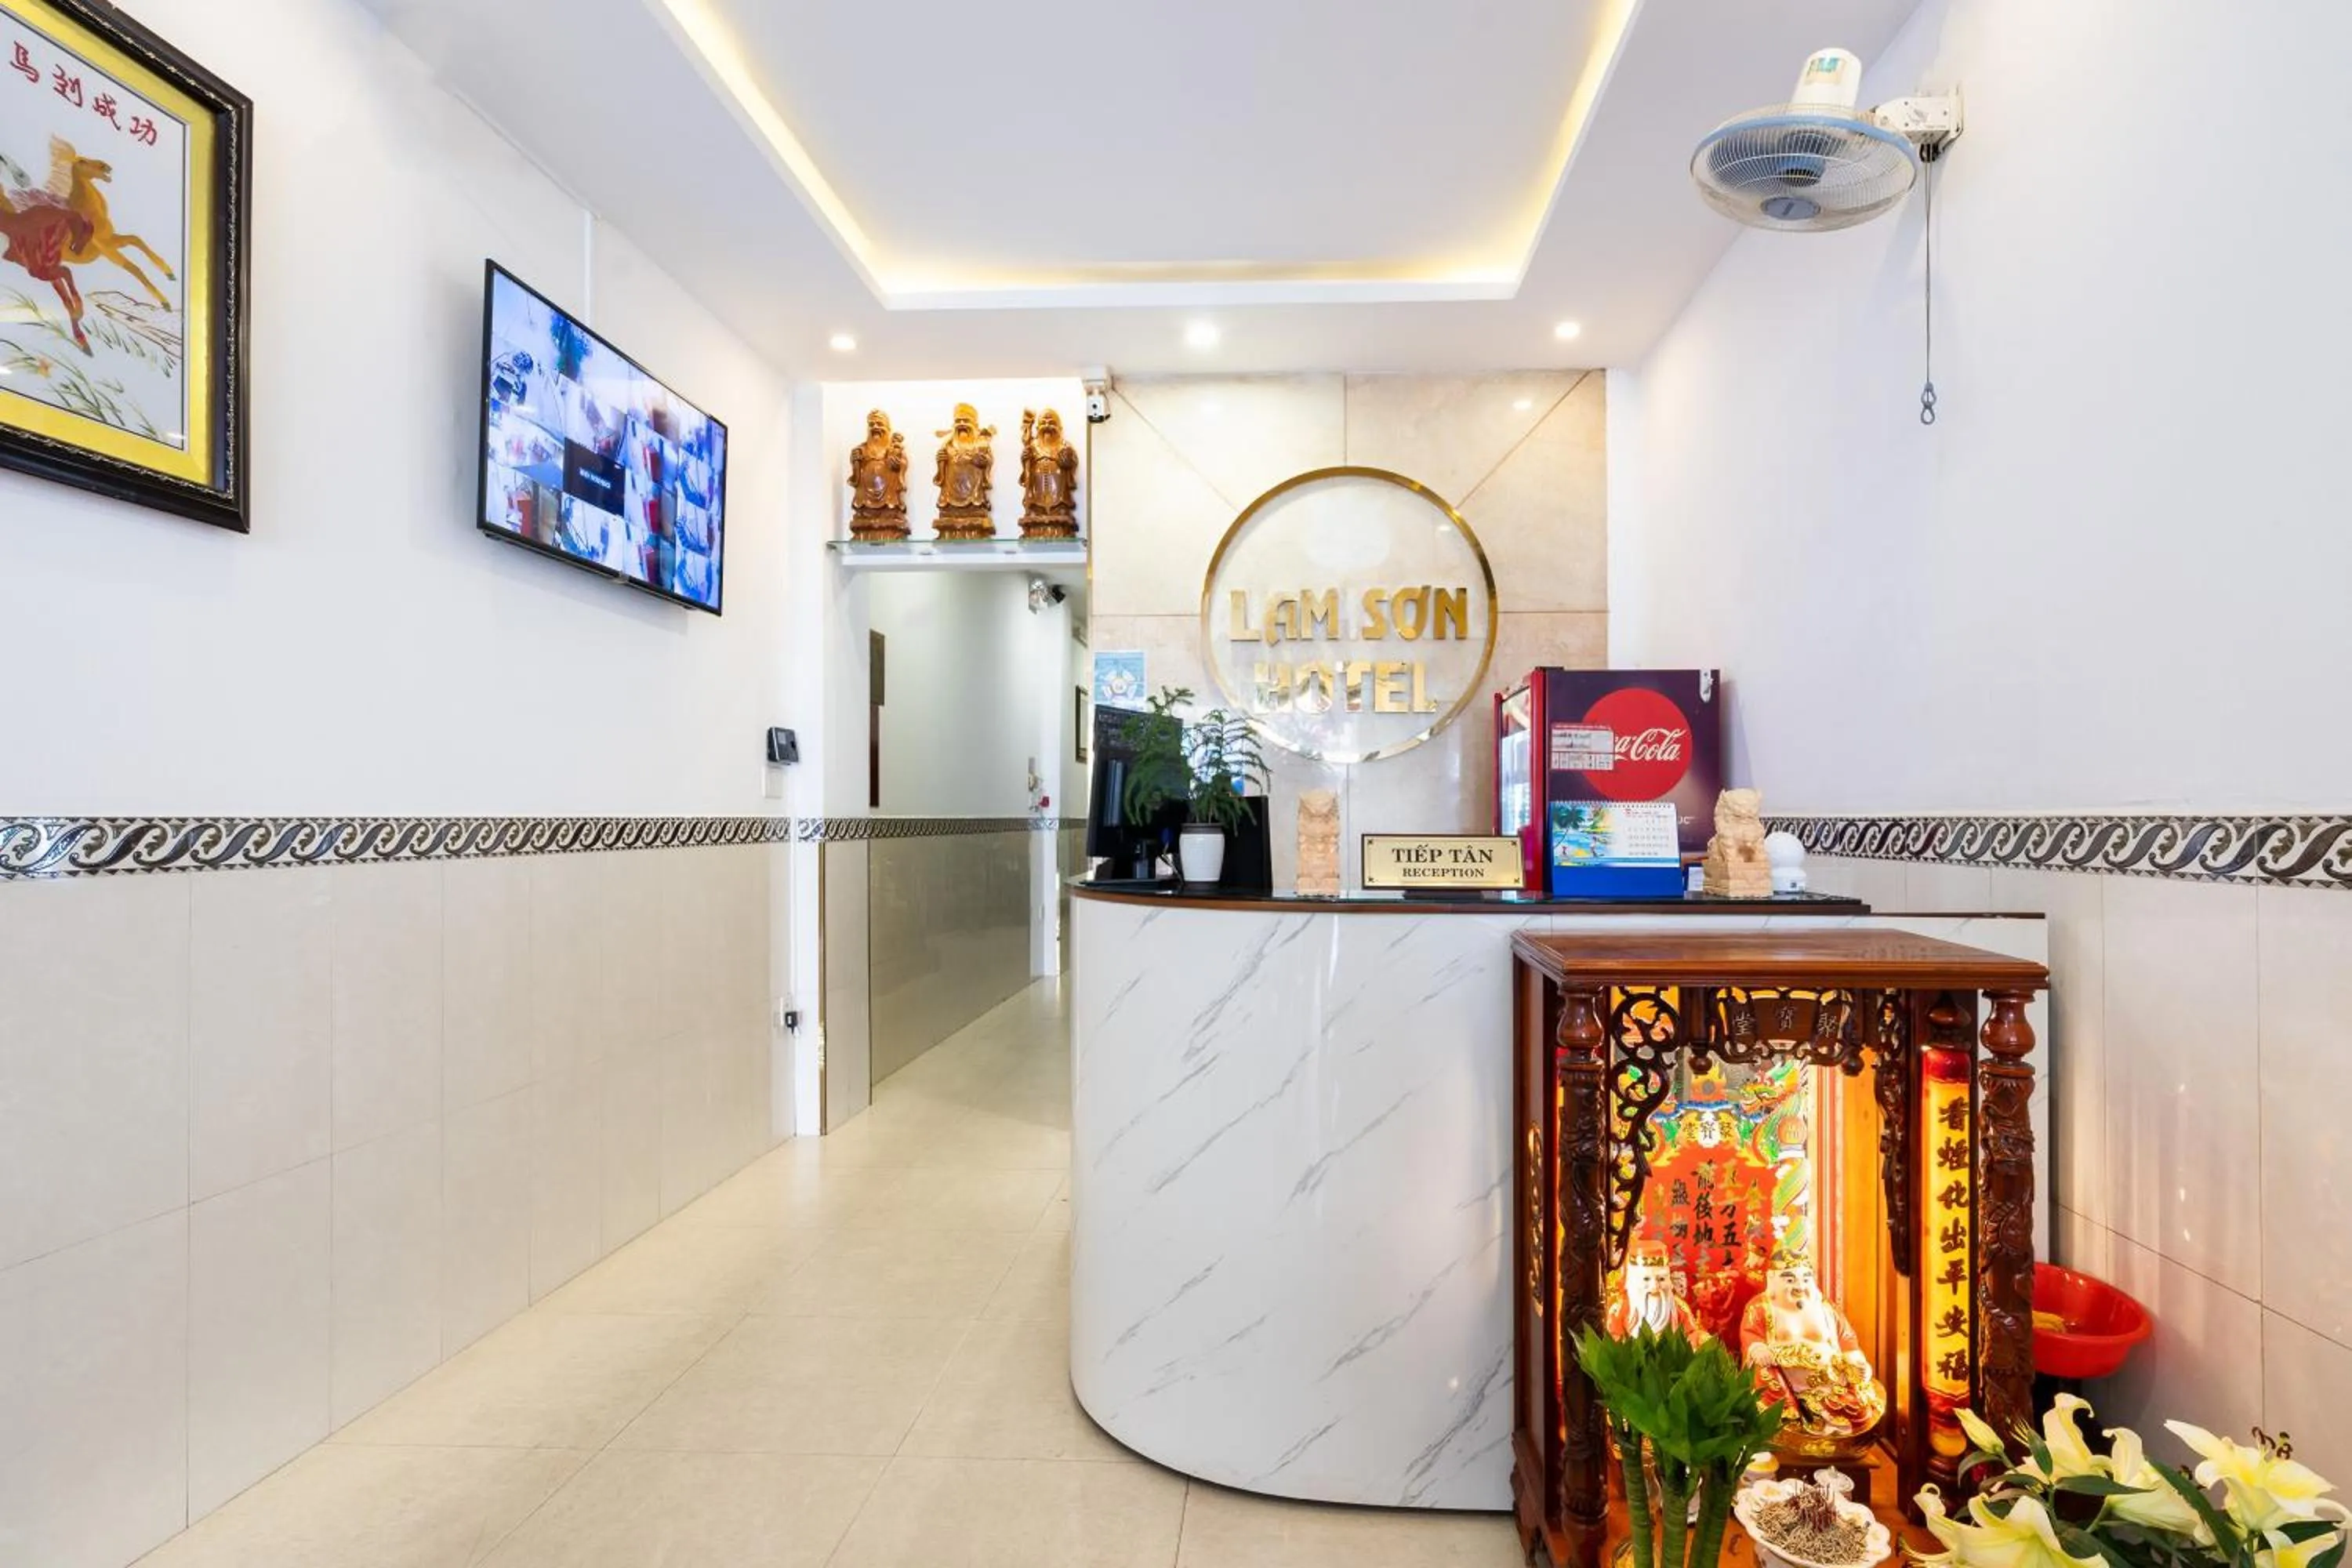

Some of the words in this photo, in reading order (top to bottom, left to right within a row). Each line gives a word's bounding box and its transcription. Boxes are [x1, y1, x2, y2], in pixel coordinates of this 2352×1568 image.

[1229, 587, 1340, 647] LAM
[1362, 585, 1468, 641] SƠN
[1252, 661, 1437, 714] HOTEL
[1614, 728, 1687, 761] a-Cola
[1392, 844, 1443, 863] TIẾP
[1448, 844, 1494, 863] TÂN
[1402, 868, 1485, 877] RECEPTION
